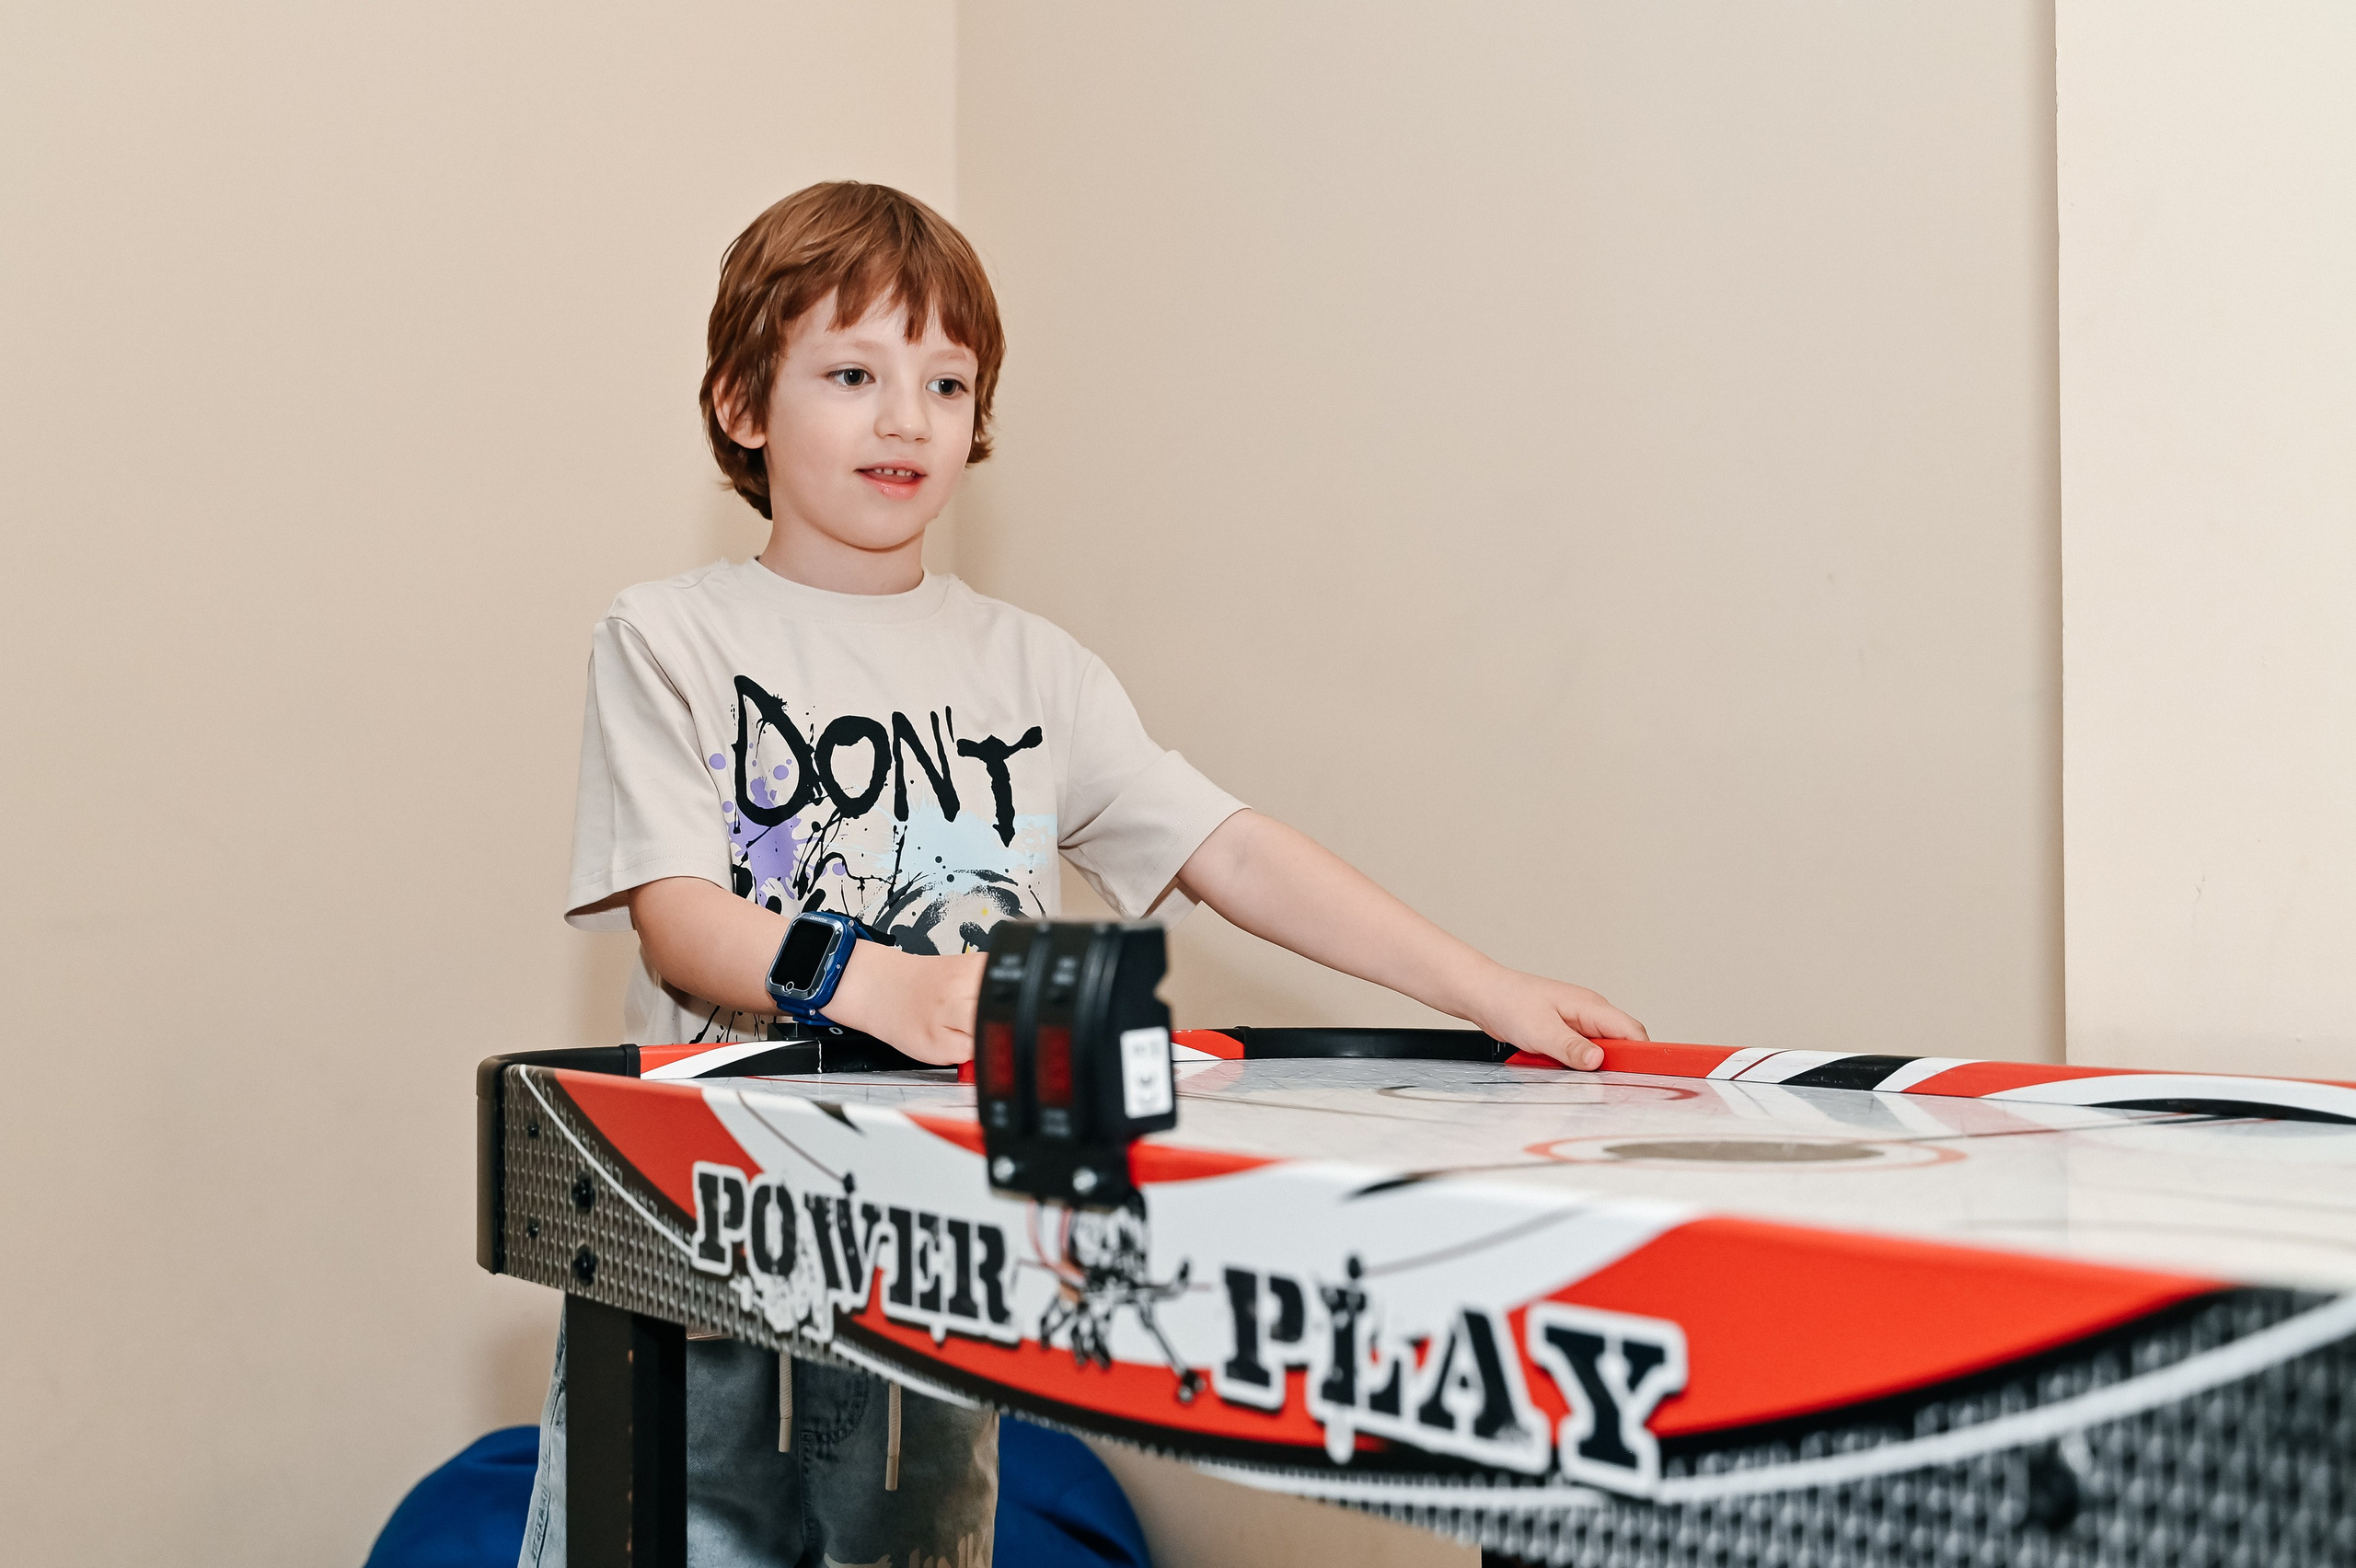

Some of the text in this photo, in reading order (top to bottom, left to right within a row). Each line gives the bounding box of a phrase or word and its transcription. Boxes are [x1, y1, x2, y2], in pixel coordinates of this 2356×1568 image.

[732, 674, 1044, 847] DON'T
[696, 1170, 1667, 1472] POWER PLAY
